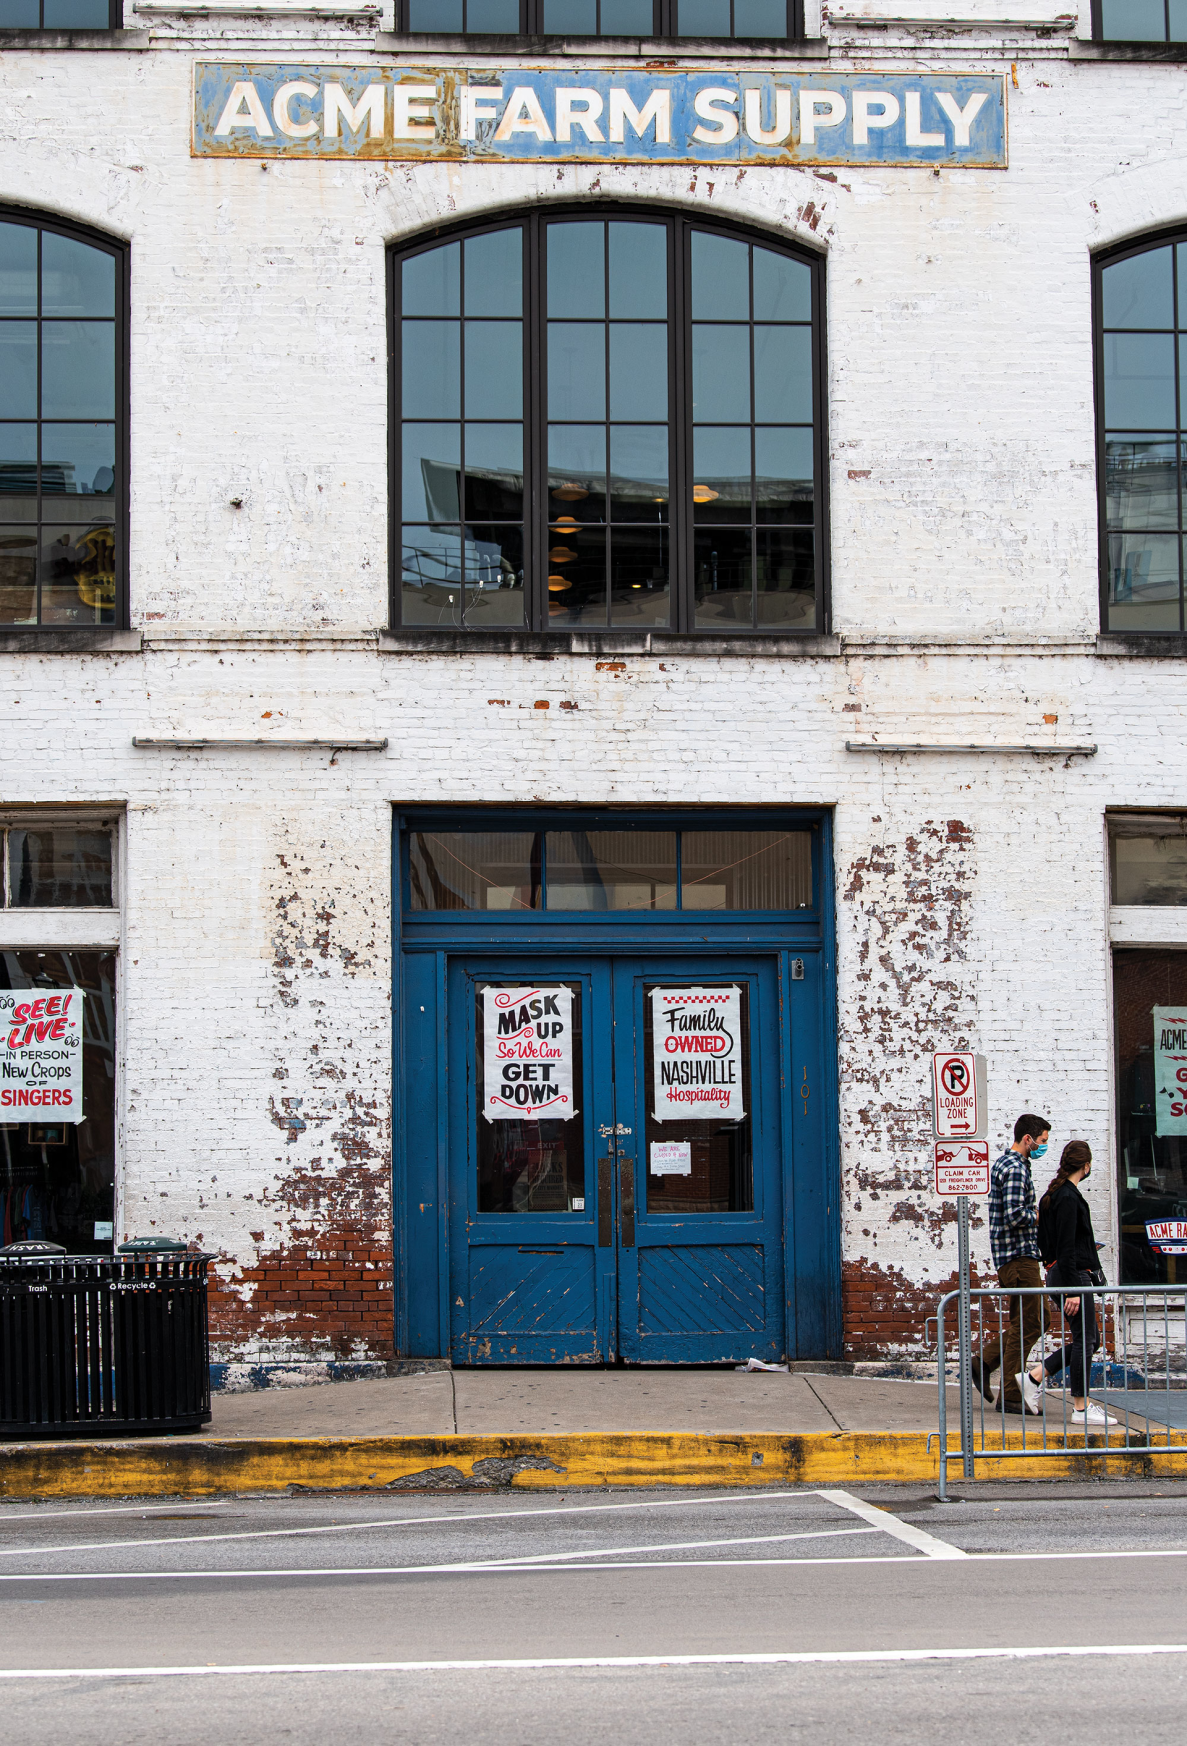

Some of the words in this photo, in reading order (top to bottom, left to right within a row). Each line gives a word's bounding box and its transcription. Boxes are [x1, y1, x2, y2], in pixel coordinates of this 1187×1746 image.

[214, 80, 437, 139] ACME
[460, 85, 671, 143] FARM
[692, 87, 989, 147] SUPPLY
[8, 994, 73, 1026] SEE!
[497, 994, 561, 1035] MASK
[7, 1017, 68, 1050] LIVE
[537, 1022, 564, 1039] UP
[662, 1006, 733, 1059] Family
[1160, 1029, 1187, 1050] ACME
[495, 1042, 517, 1058] So
[514, 1041, 540, 1058] We
[539, 1041, 562, 1058] Can
[664, 1035, 726, 1053] OWNED
[21, 1050, 69, 1060] PERSON
[502, 1063, 556, 1081] GET
[661, 1060, 736, 1085] NASHVILLE
[0, 1089, 73, 1106] SINGERS
[501, 1084, 559, 1105] DOWN
[666, 1086, 731, 1109] Hospitality
[940, 1097, 974, 1108] LOADING
[947, 1108, 968, 1119] ZONE
[1149, 1223, 1173, 1238] ACME
[117, 1282, 148, 1290] Recycle
